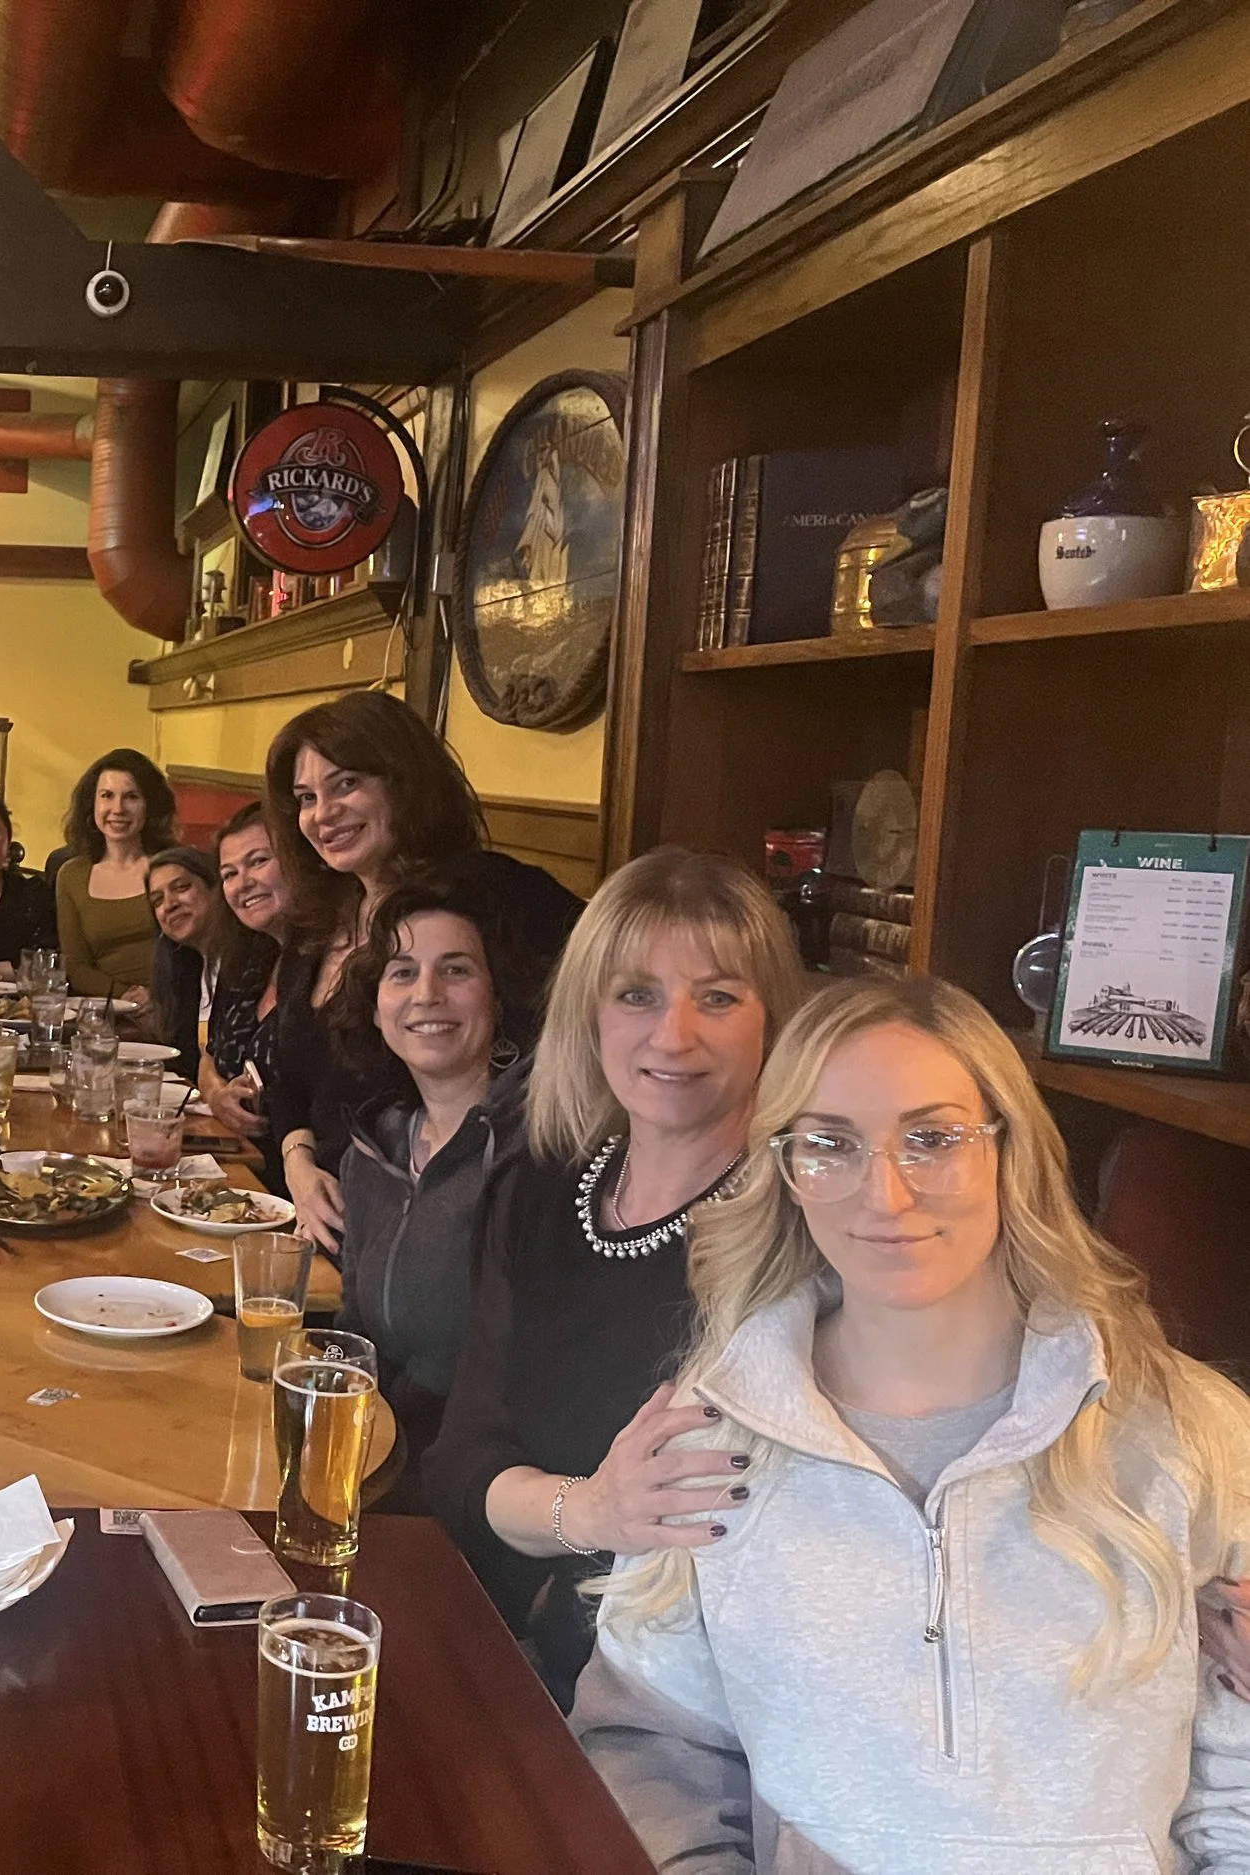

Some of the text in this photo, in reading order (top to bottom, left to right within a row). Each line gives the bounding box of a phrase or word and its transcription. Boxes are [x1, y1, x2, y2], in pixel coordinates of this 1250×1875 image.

[267, 468, 374, 503] RICKARD'S
[1137, 856, 1183, 870] WINE
[341, 1736, 356, 1749] CO
